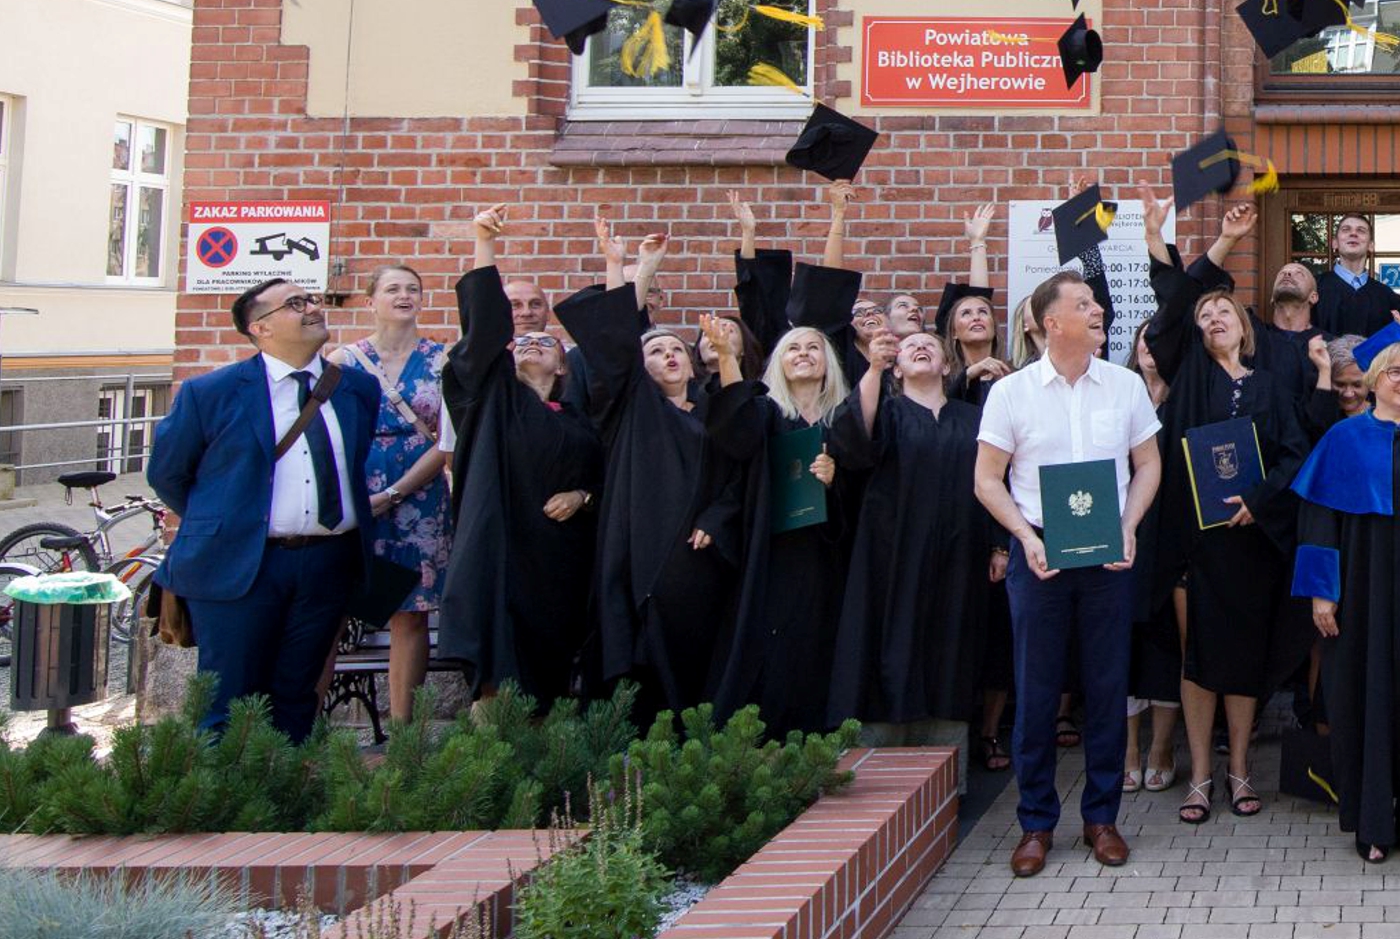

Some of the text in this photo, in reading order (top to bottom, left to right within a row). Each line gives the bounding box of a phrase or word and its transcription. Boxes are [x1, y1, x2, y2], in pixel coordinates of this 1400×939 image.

[924, 29, 1029, 46] Powiatowa
[878, 51, 1063, 67] Biblioteka Publiczn
[906, 74, 1046, 93] w Wejherowie
[194, 205, 325, 218] ZAKAZ PARKOWANIA
